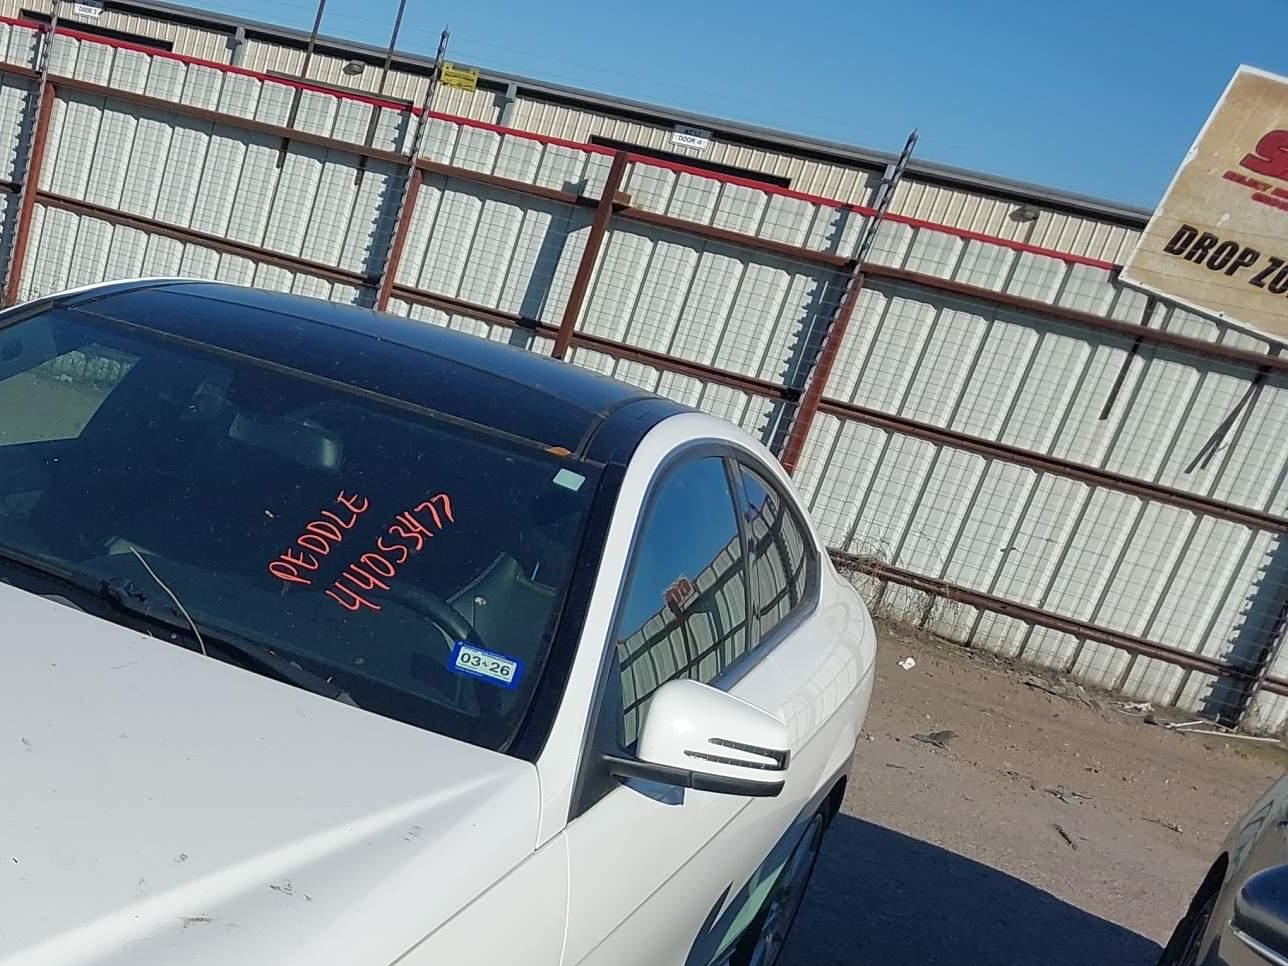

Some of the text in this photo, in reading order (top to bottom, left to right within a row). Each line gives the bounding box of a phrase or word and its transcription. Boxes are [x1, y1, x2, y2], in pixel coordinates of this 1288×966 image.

[678, 135, 696, 144] DOOR
[1163, 223, 1288, 297] DROP ZO
[268, 489, 369, 585] PEDDLE
[324, 493, 455, 612] 44053477
